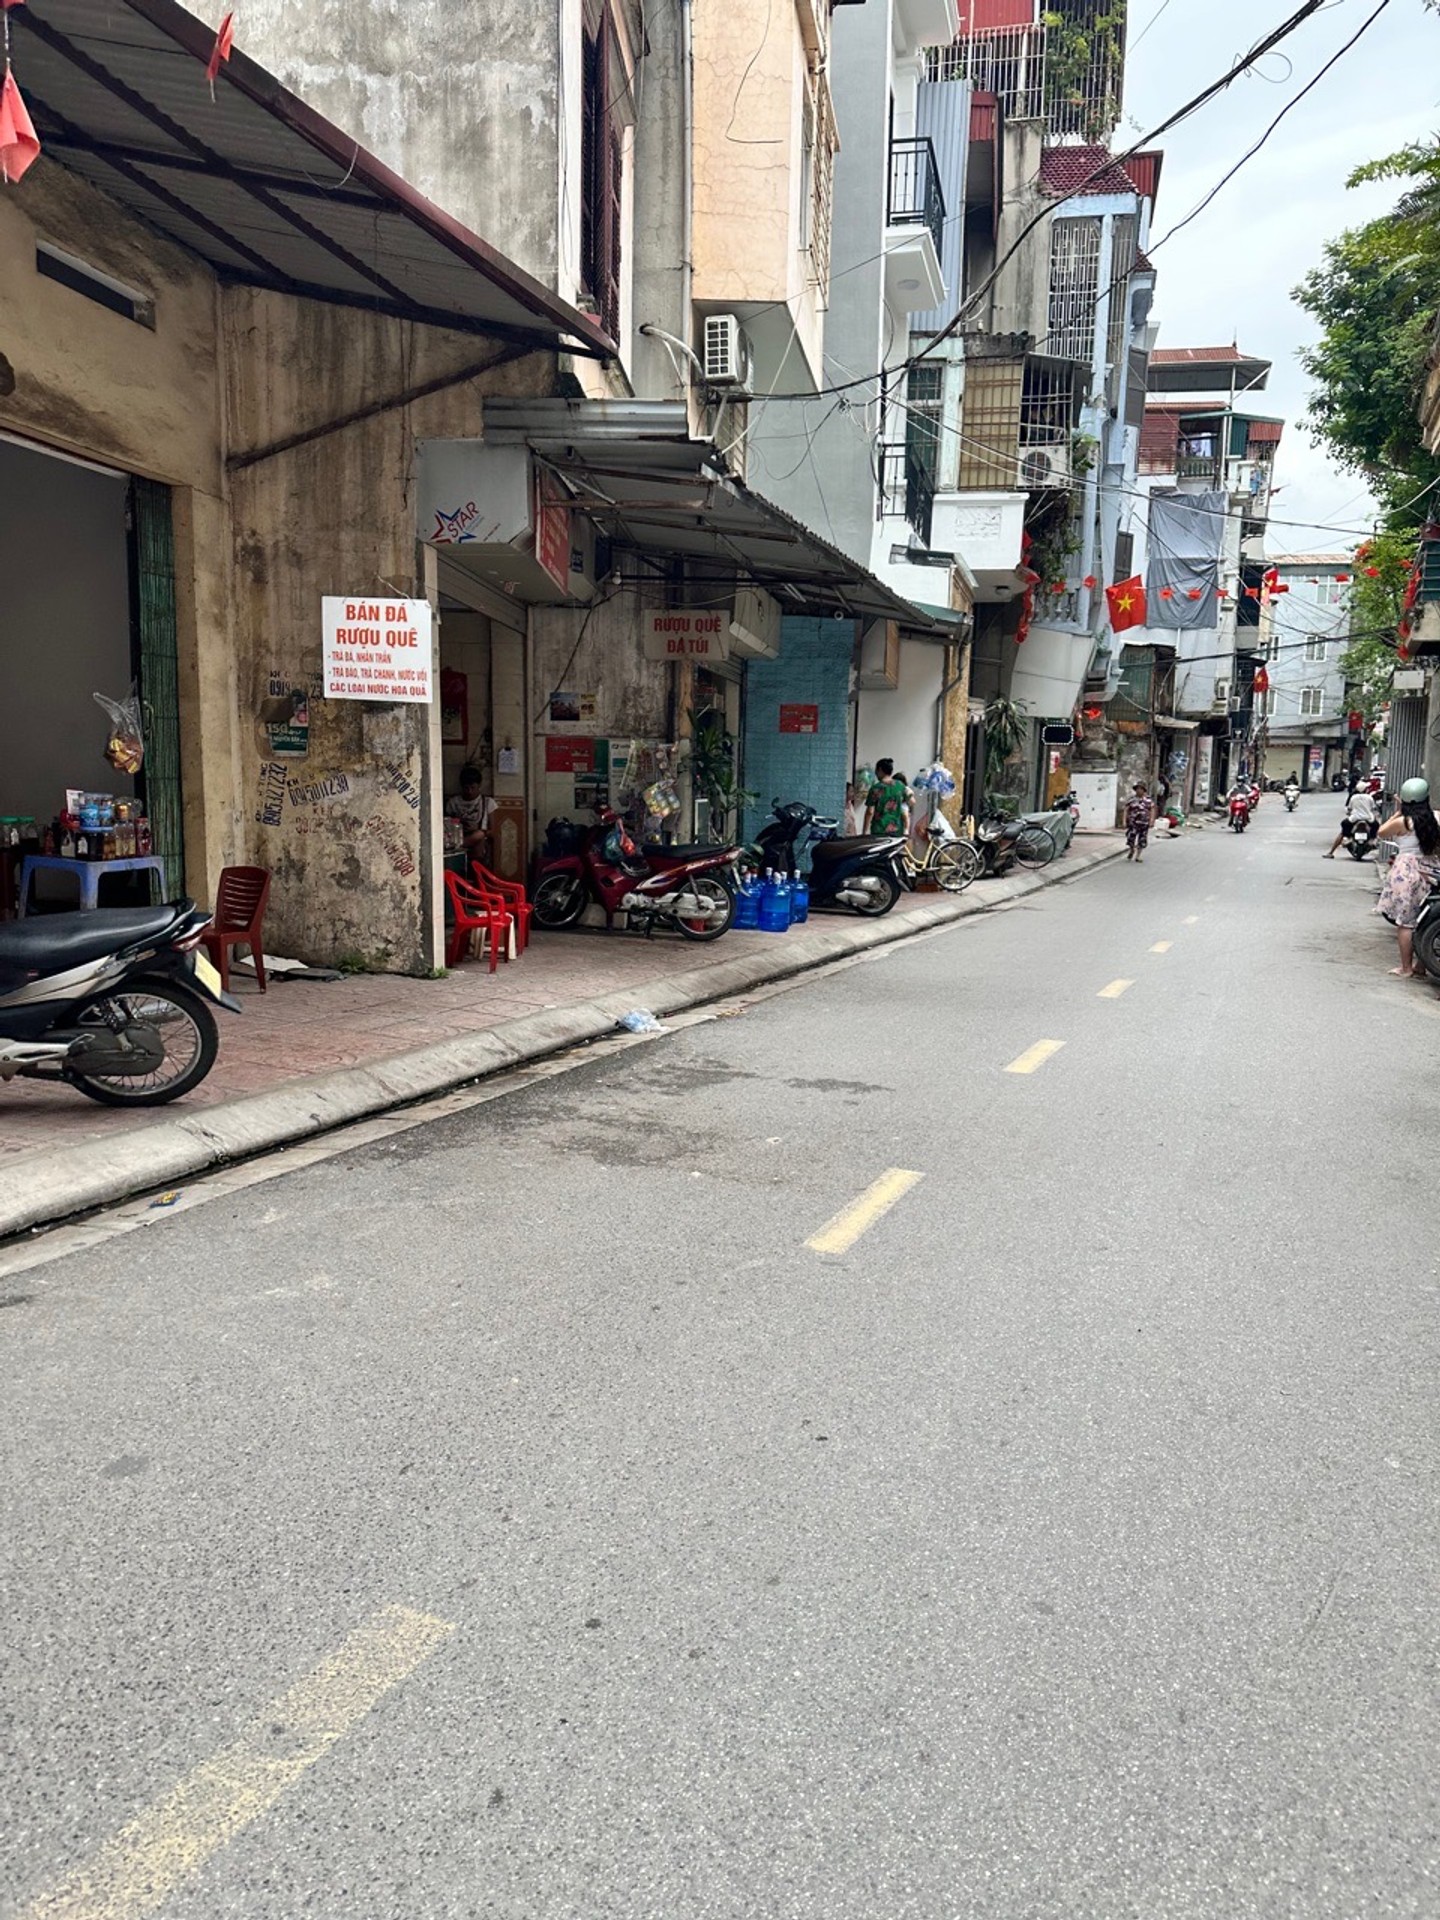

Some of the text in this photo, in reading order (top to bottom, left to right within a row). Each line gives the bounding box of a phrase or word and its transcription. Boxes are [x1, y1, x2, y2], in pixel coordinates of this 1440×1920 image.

[447, 501, 479, 538] STAR
[345, 601, 408, 622] BÁN ĐÁ
[653, 614, 722, 634] RƯỢU QUÊ
[336, 627, 418, 650] RƯỢU QUÊ
[667, 636, 709, 654] ĐÁ TÚI
[330, 679, 346, 693] CÁC
[391, 685, 408, 695] HOA
